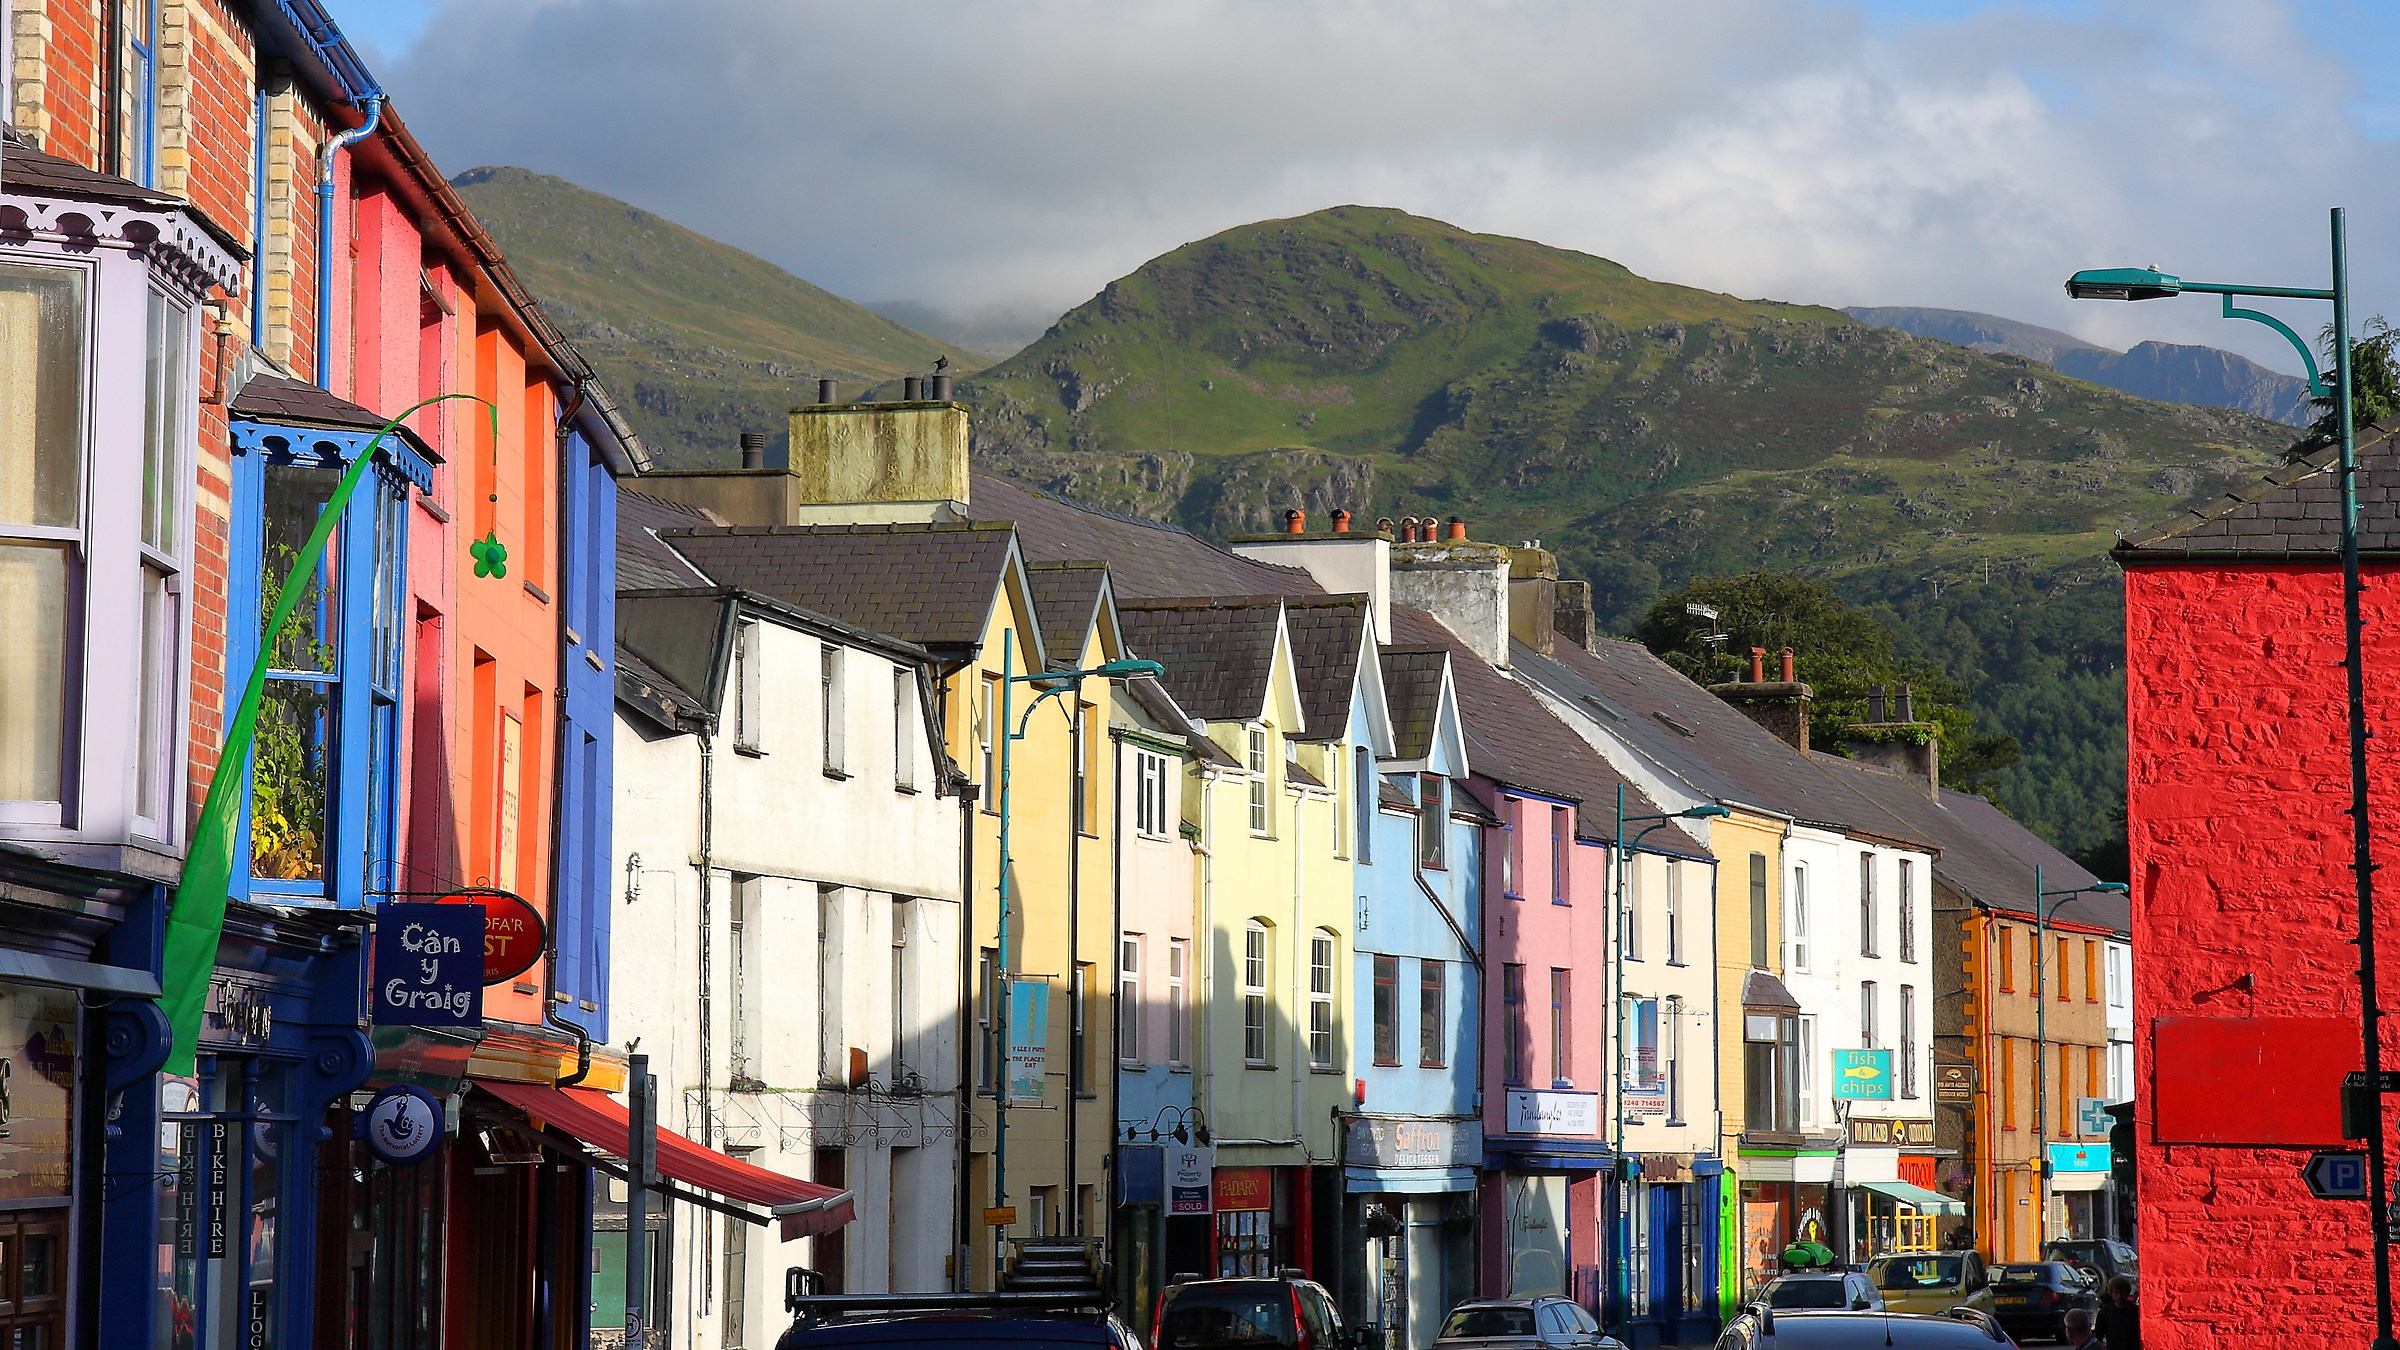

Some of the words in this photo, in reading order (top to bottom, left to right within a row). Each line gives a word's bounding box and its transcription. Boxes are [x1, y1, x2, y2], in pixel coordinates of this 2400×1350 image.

[401, 922, 461, 954] Cân
[420, 958, 438, 985] y
[385, 978, 472, 1018] Graig
[1848, 1051, 1876, 1065] fish
[1841, 1080, 1883, 1096] chips
[1395, 1123, 1440, 1153] Saffron
[212, 1124, 226, 1185] BIKE
[1394, 1154, 1440, 1165] DELICATESSEN
[1220, 1180, 1259, 1196] PADARN
[2336, 1164, 2355, 1187] P
[1178, 1202, 1203, 1211] SOLD
[210, 1191, 225, 1254] HIRE
[251, 1291, 264, 1350] LLOG
